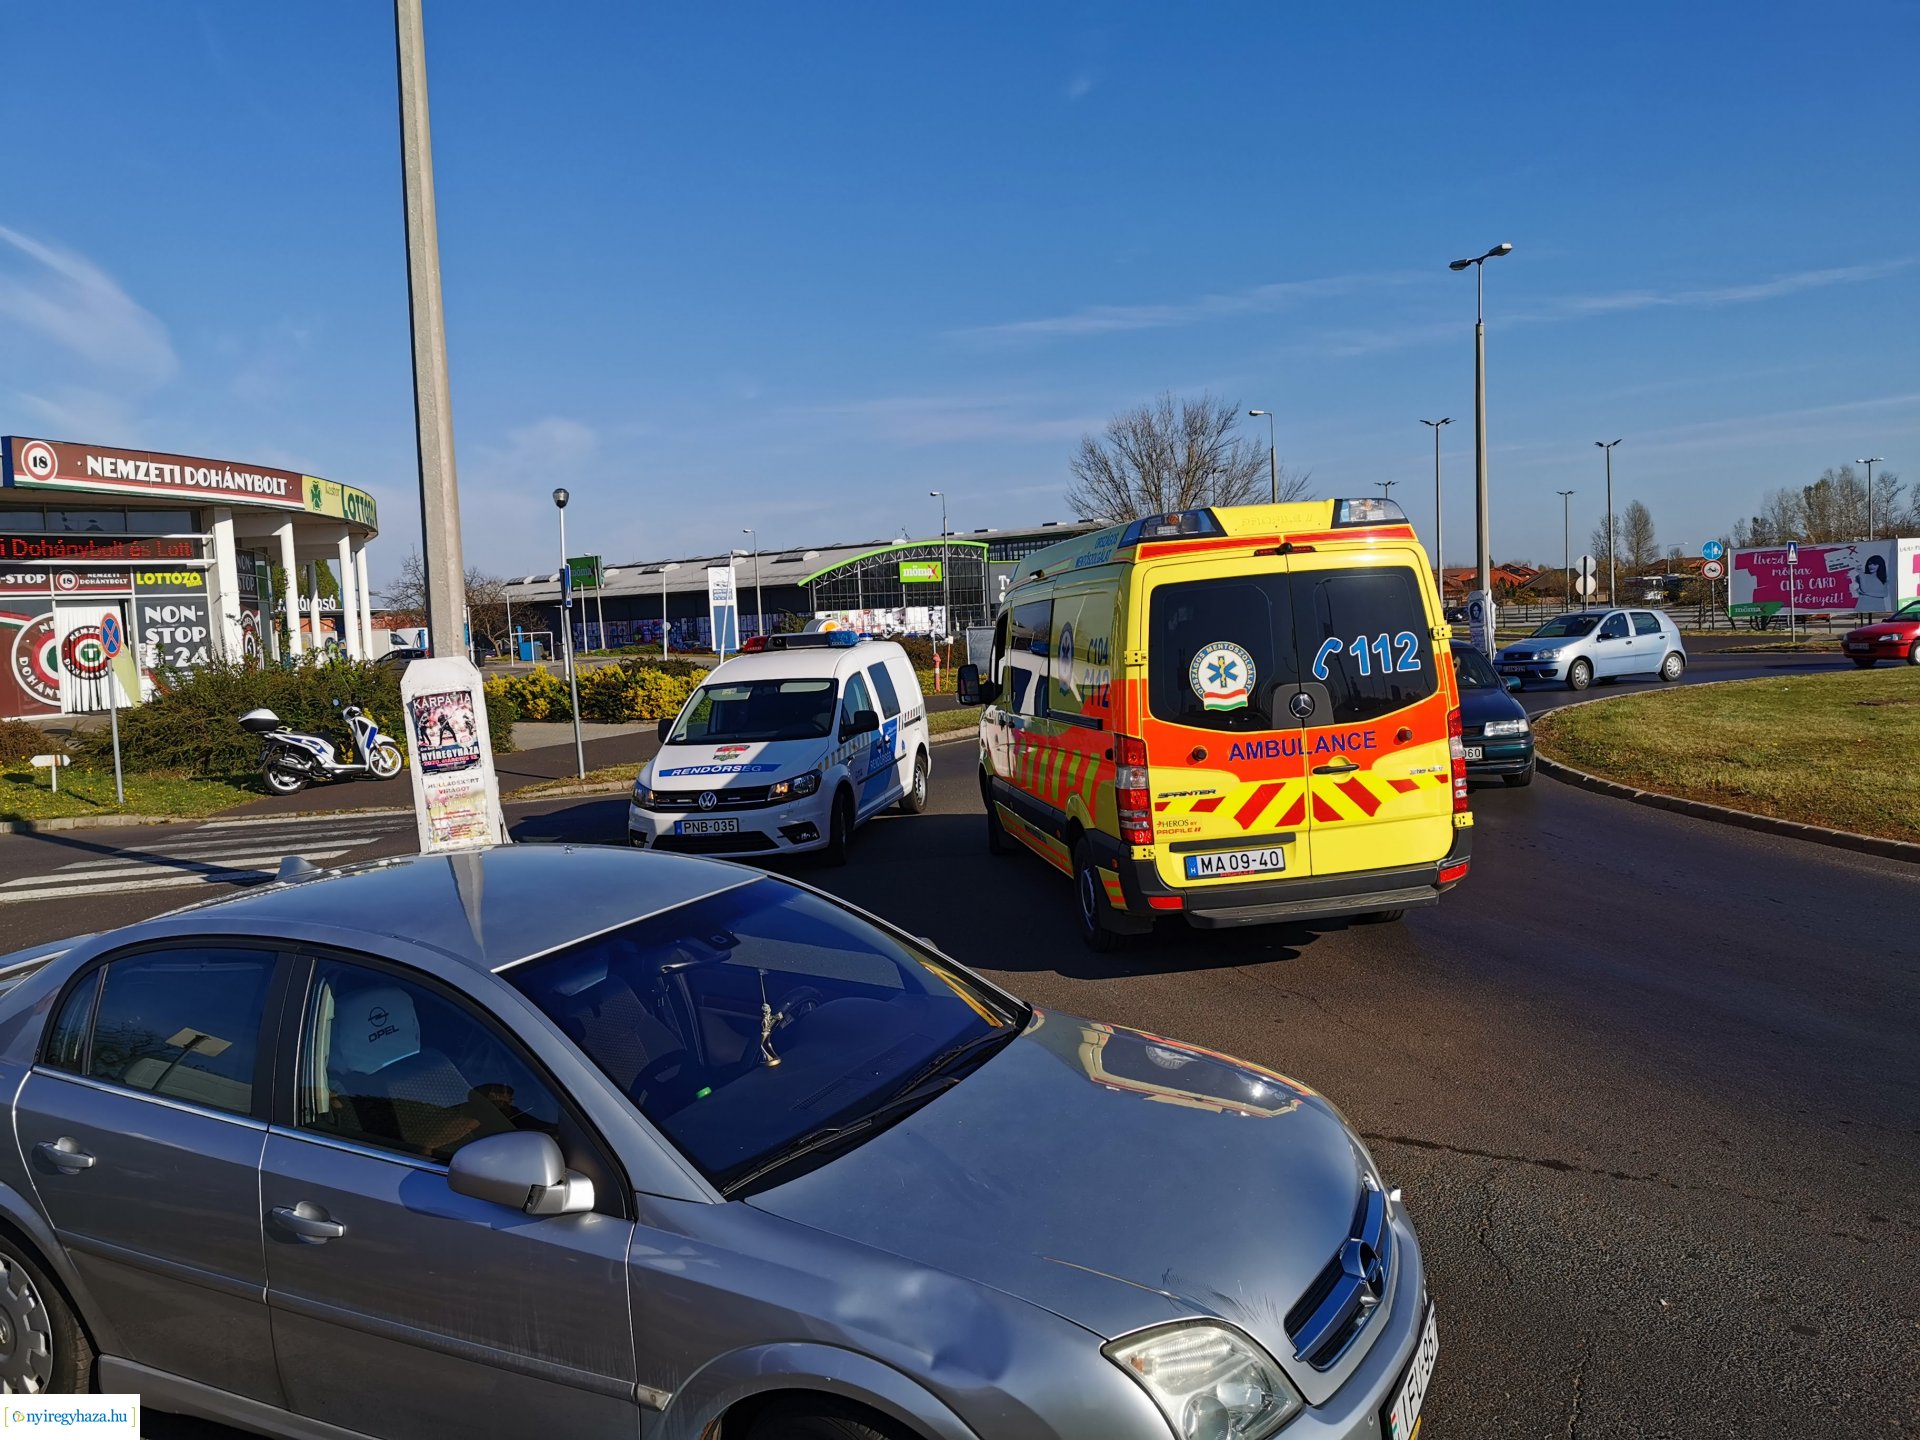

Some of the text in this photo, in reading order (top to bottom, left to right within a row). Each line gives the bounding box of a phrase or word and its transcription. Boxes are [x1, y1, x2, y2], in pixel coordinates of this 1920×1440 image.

[32, 455, 49, 469] 18
[86, 455, 288, 496] NEMZETI DOHÁNYBOLT
[144, 605, 205, 624] NON-
[145, 626, 207, 645] STOP
[1348, 631, 1422, 676] 112
[413, 693, 472, 709] KÁRPÁIA
[1228, 730, 1377, 763] AMBULANCE
[1157, 789, 1217, 799] SPRINTER
[684, 820, 735, 833] PNB-035
[1156, 827, 1193, 835] PROFILE
[1162, 820, 1189, 828] HEROS
[368, 1025, 400, 1043] OPEL
